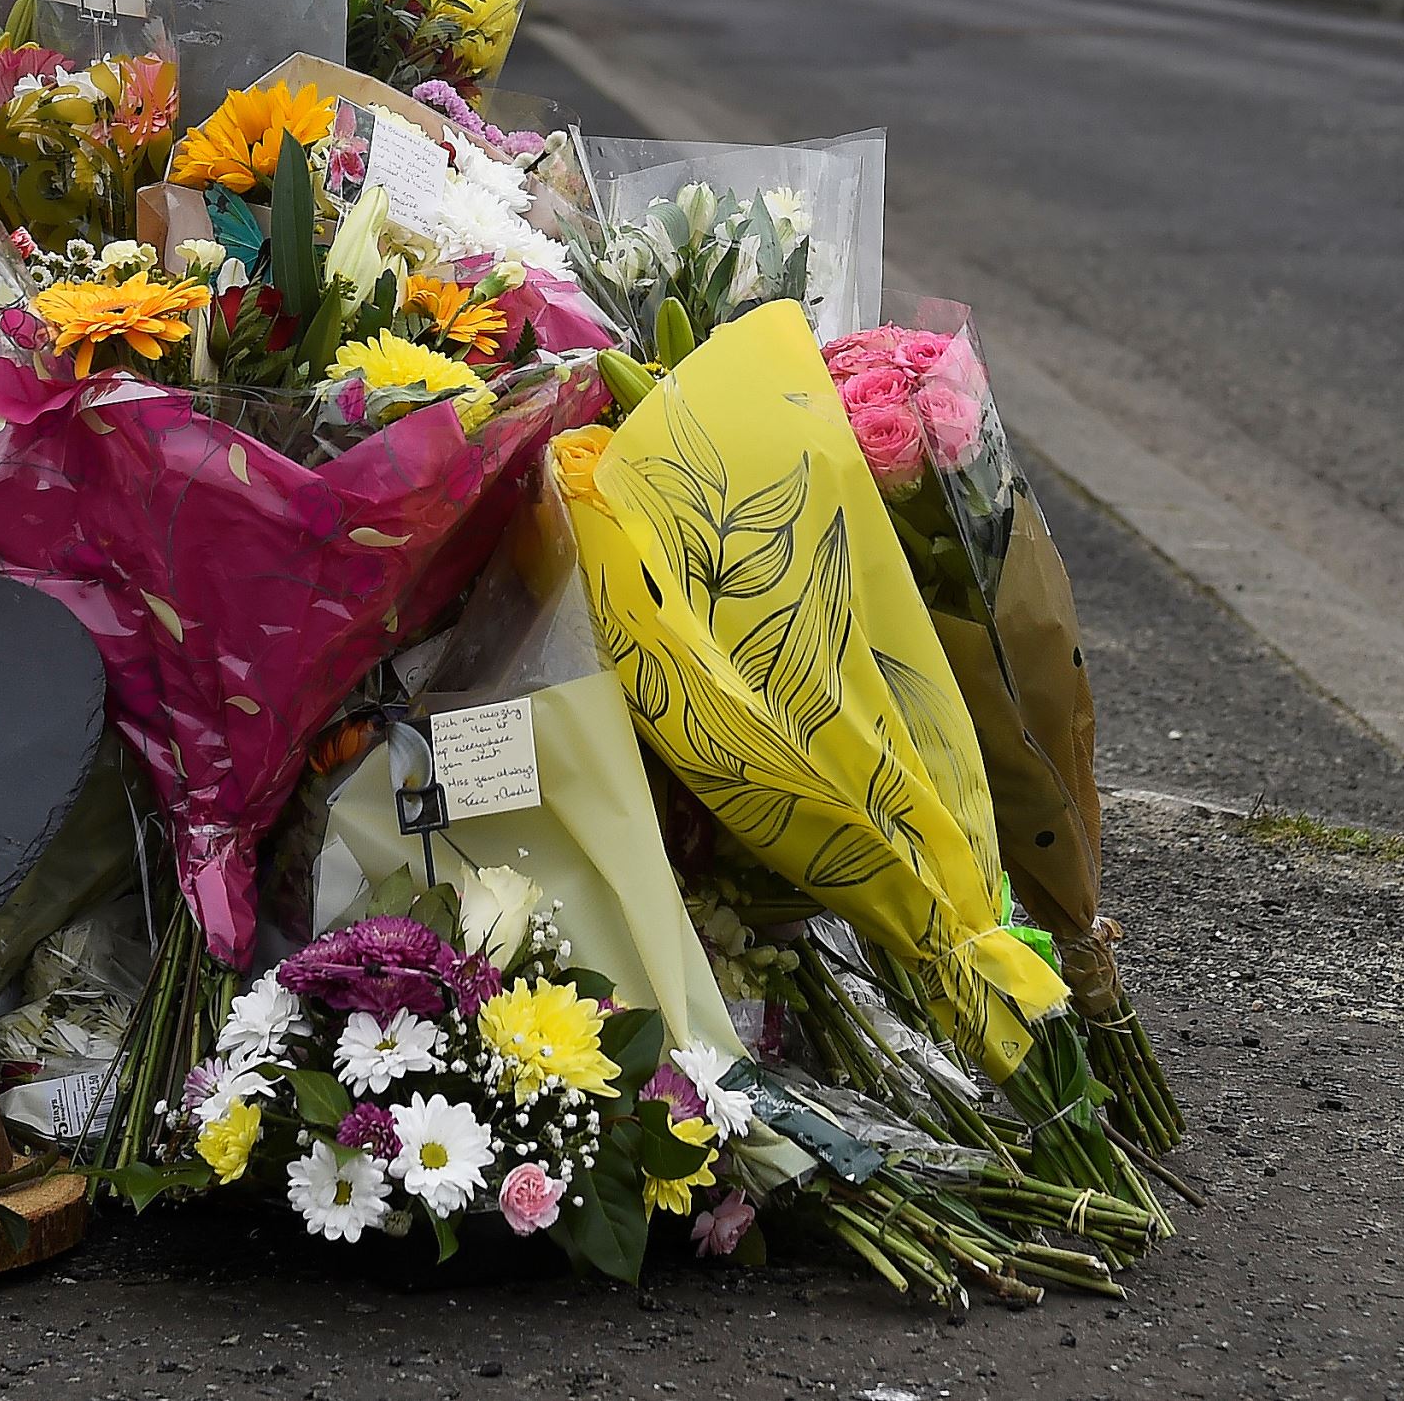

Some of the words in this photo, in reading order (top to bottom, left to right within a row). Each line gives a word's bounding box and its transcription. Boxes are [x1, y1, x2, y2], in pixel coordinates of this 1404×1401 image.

[434, 718, 457, 731] Such
[479, 705, 522, 720] amazing
[448, 778, 469, 788] Miss
[474, 773, 495, 788] you
[496, 764, 534, 779] always
[53, 1121, 69, 1137] 5
